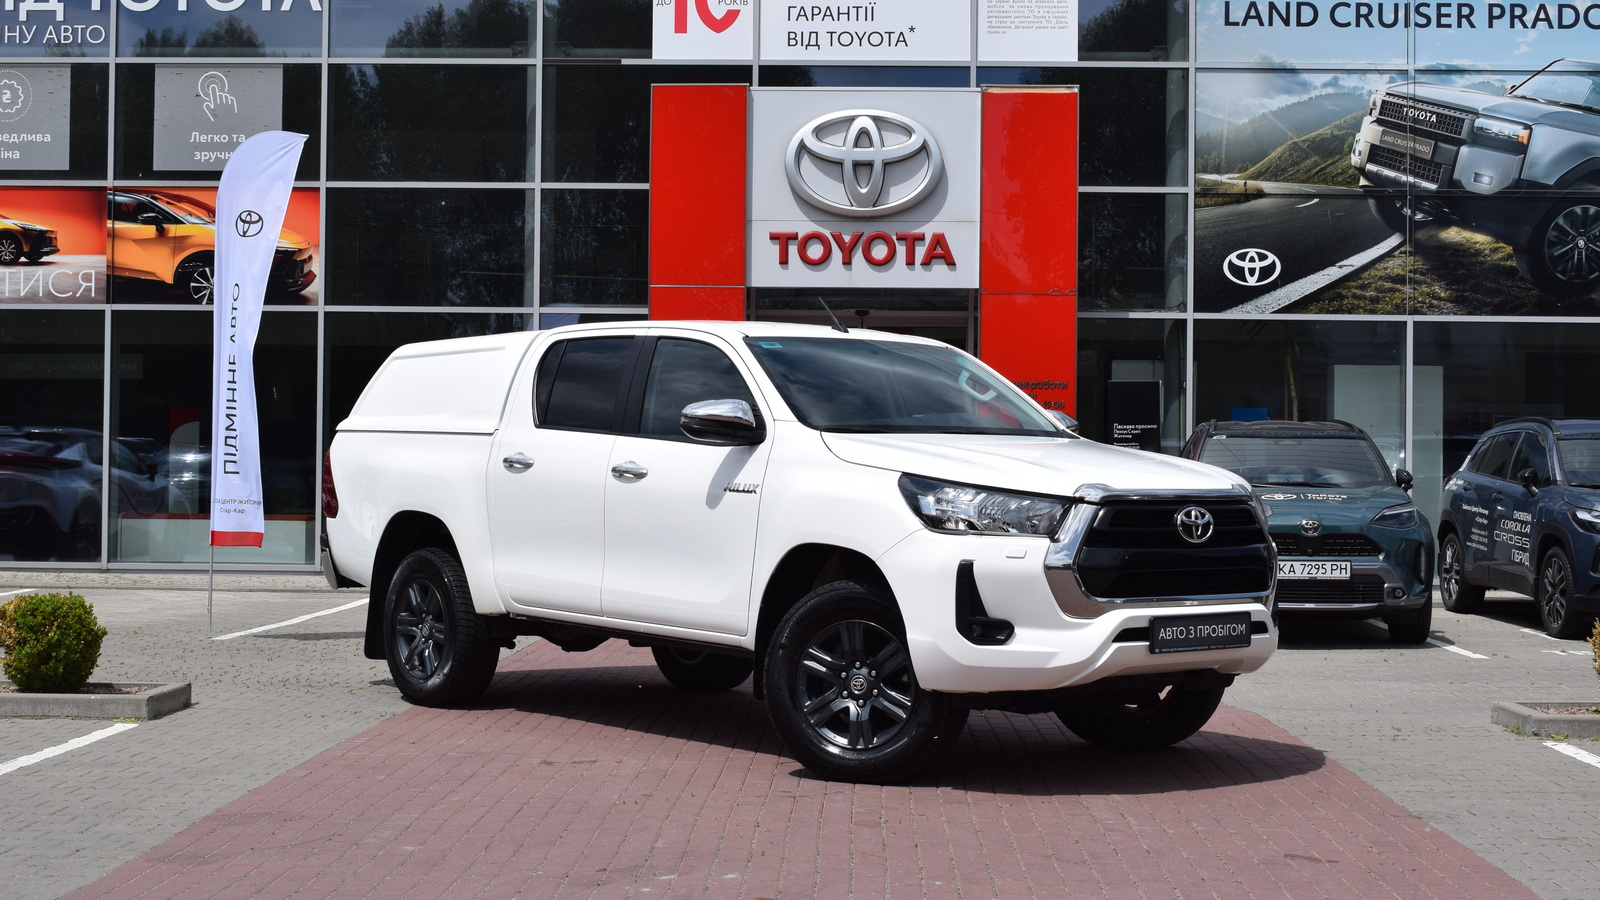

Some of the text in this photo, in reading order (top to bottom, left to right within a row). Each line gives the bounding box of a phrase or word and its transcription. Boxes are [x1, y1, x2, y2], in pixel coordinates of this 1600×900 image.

[787, 2, 876, 22] ГАРАНТІЇ
[1224, 1, 1319, 27] LAND
[1329, 2, 1476, 29] CRUISER
[4, 25, 105, 44] НУ АВТО
[787, 31, 820, 50] ВІД
[1403, 107, 1437, 123] TOYOTA
[0, 133, 51, 143] едлива
[190, 131, 246, 143] Легко та
[1382, 135, 1394, 143] LAND
[1395, 138, 1414, 148] CRUISER
[1, 147, 20, 159] іна
[193, 151, 233, 163] зручн
[769, 230, 957, 267] TOYOTA
[0, 269, 96, 297] ТИСЯ
[1030, 379, 1068, 391] роботи
[223, 354, 240, 475] ПІДМІННЕ
[1500, 519, 1531, 534] COROLLA
[1493, 530, 1530, 548] CROSS
[1278, 563, 1348, 575] KA 7295 PH
[1158, 627, 1186, 640] АВТО
[1197, 623, 1246, 637] ПРОБІГОМ
